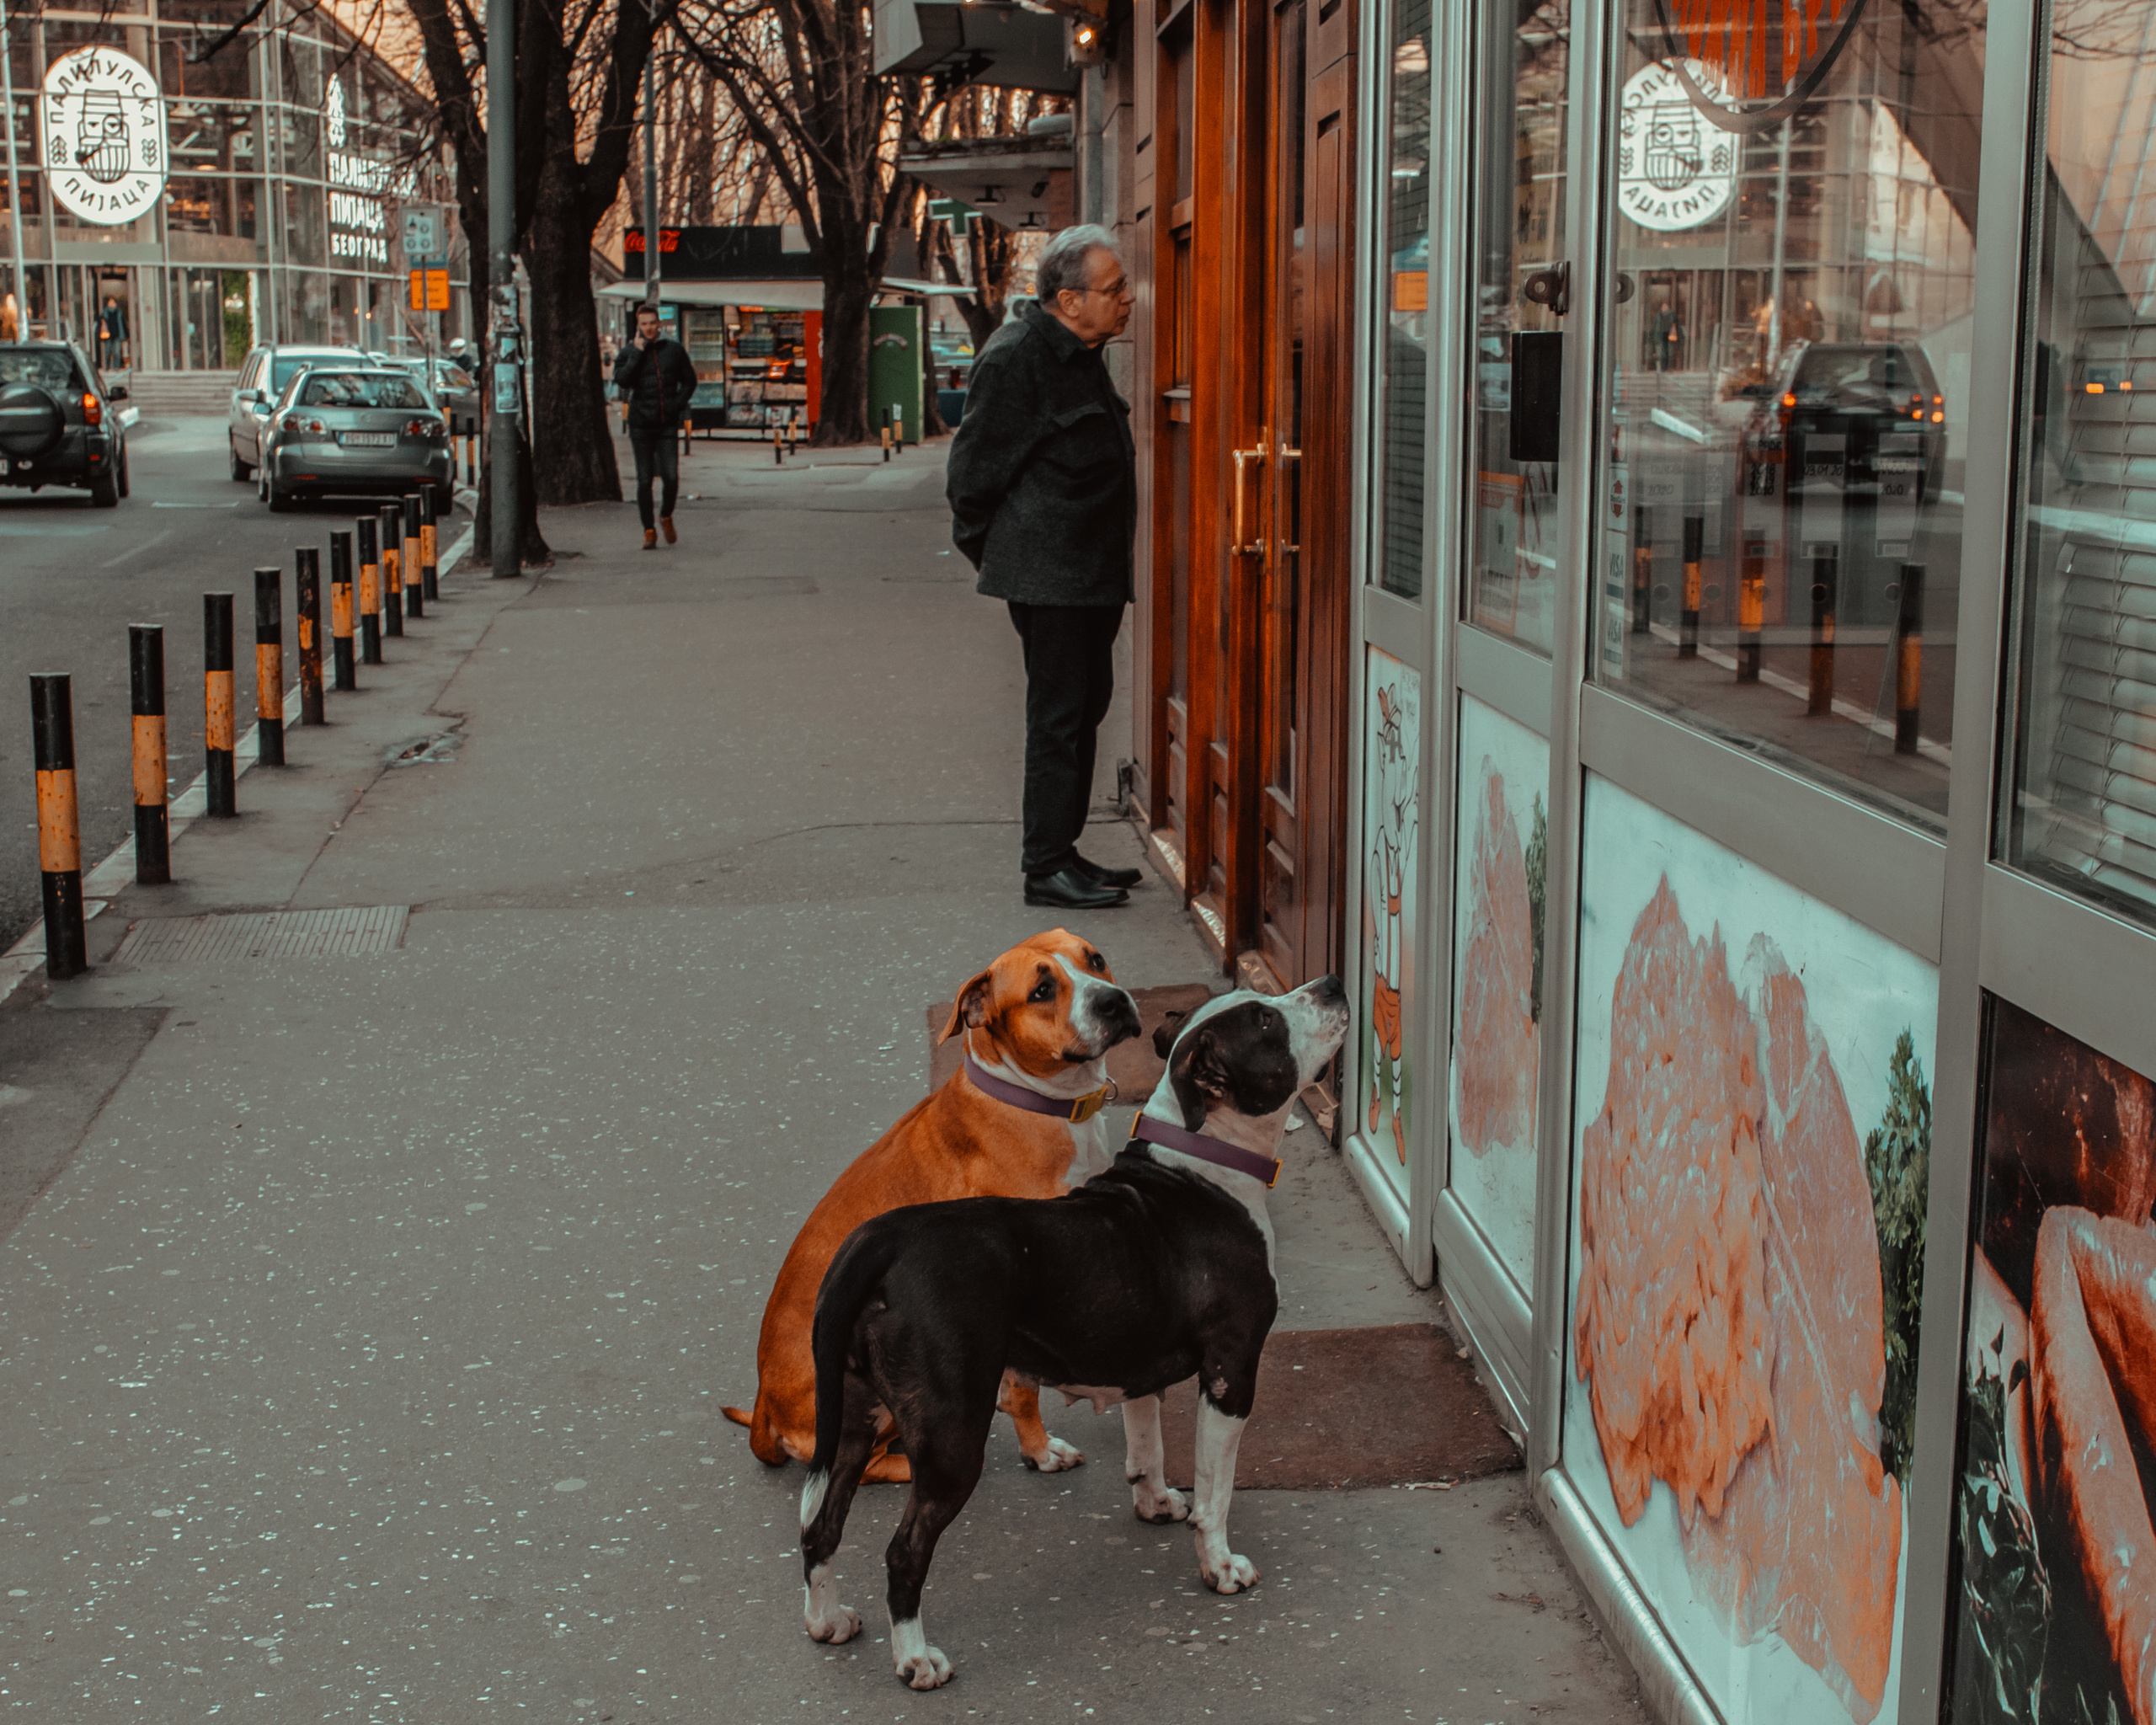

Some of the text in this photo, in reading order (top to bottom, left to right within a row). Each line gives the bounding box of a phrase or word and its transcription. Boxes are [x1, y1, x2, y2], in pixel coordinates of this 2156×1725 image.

[50, 59, 155, 127] ПАЛИЛУЛСКА
[64, 177, 150, 211] ПИЈАЦА
[329, 191, 385, 233] ПИЈАЦА
[331, 232, 387, 264] БЕОГРАД
